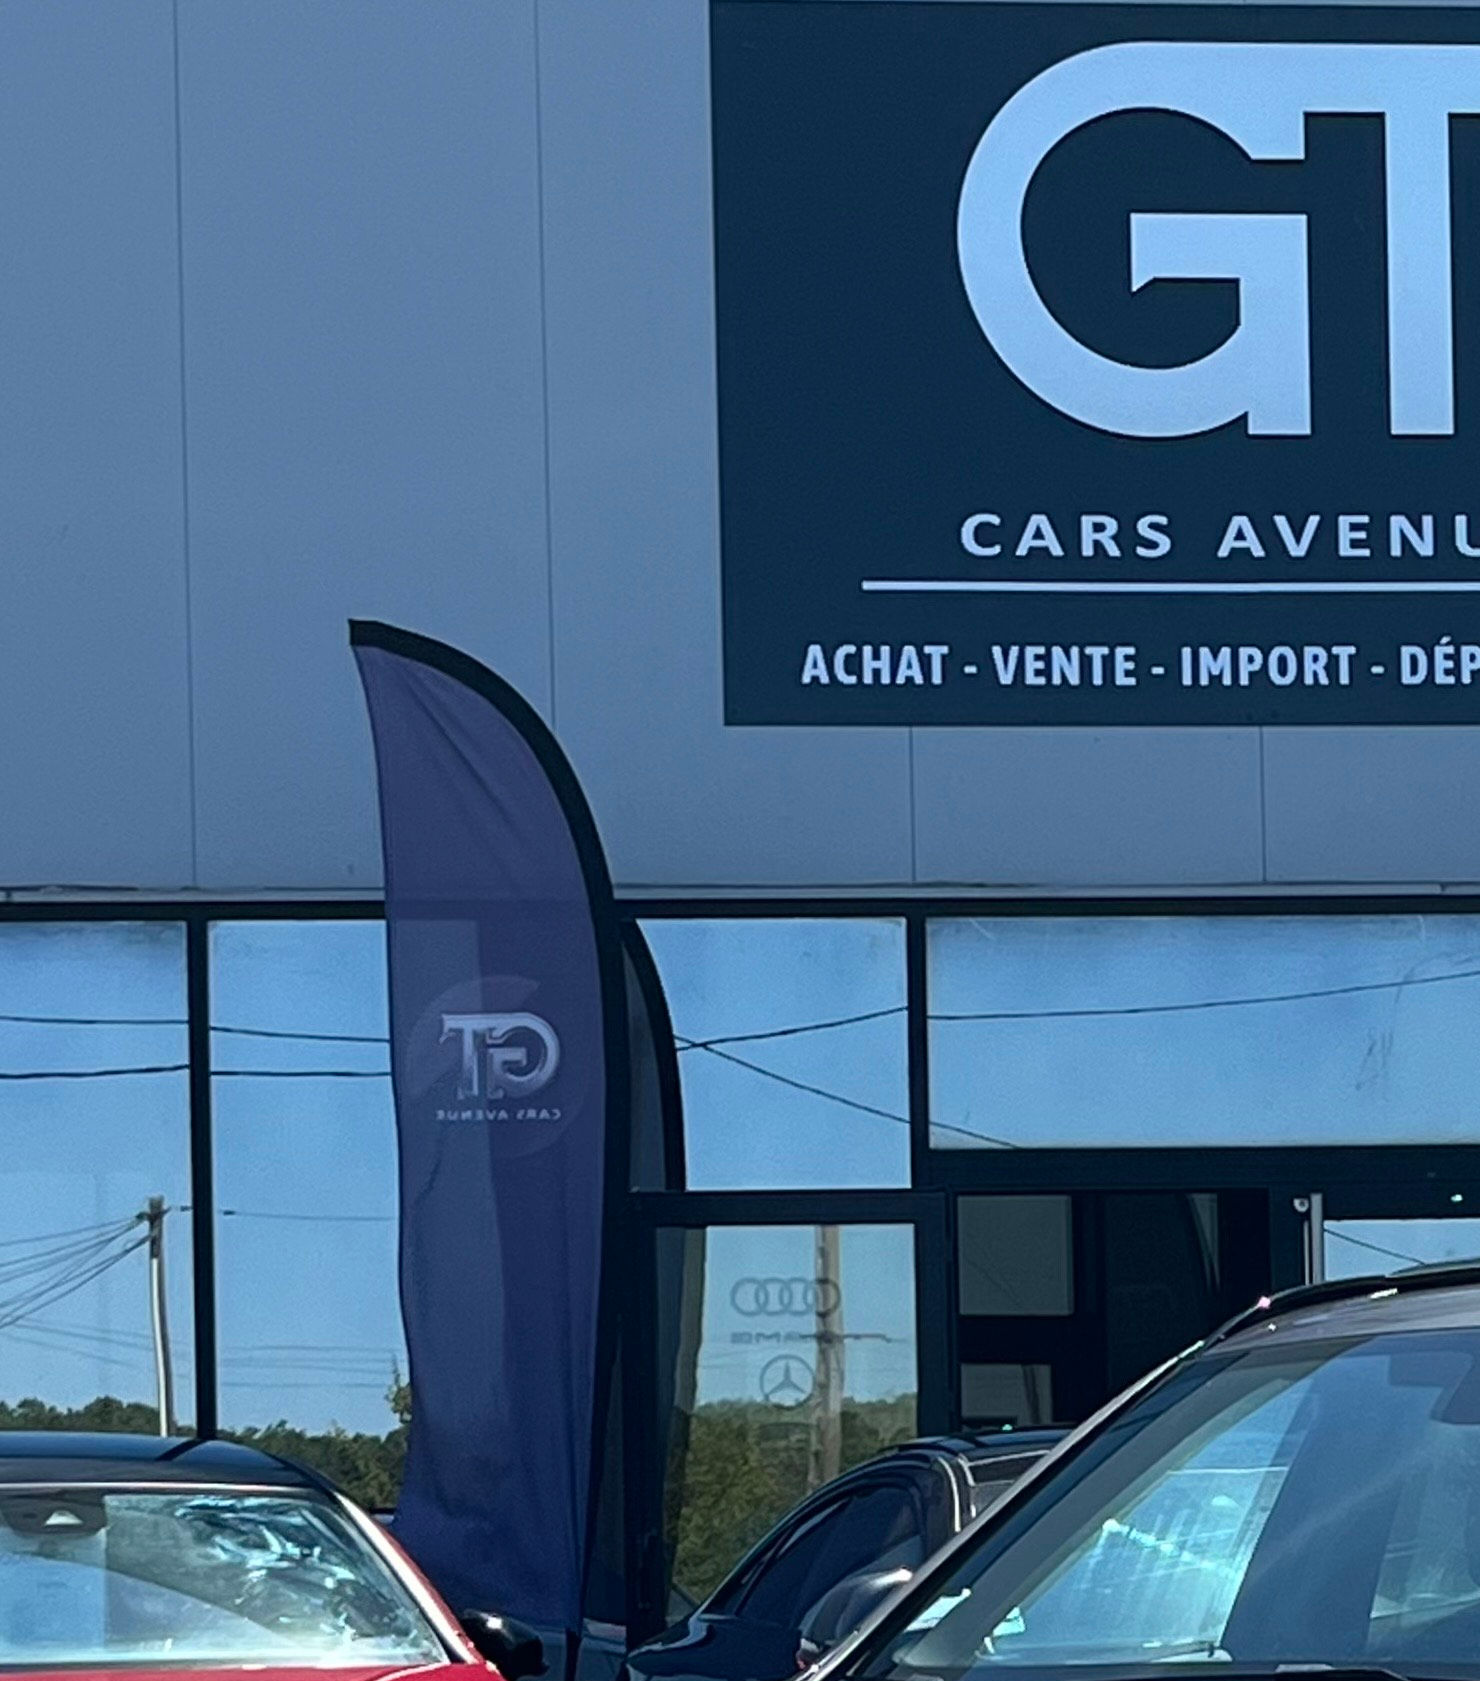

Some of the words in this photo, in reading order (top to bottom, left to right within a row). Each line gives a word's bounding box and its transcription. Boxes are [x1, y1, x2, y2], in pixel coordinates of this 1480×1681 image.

[960, 513, 1172, 558] CARS
[801, 644, 949, 685] ACHAT
[991, 645, 1137, 686] VENTE
[1181, 645, 1357, 687] IMPORT
